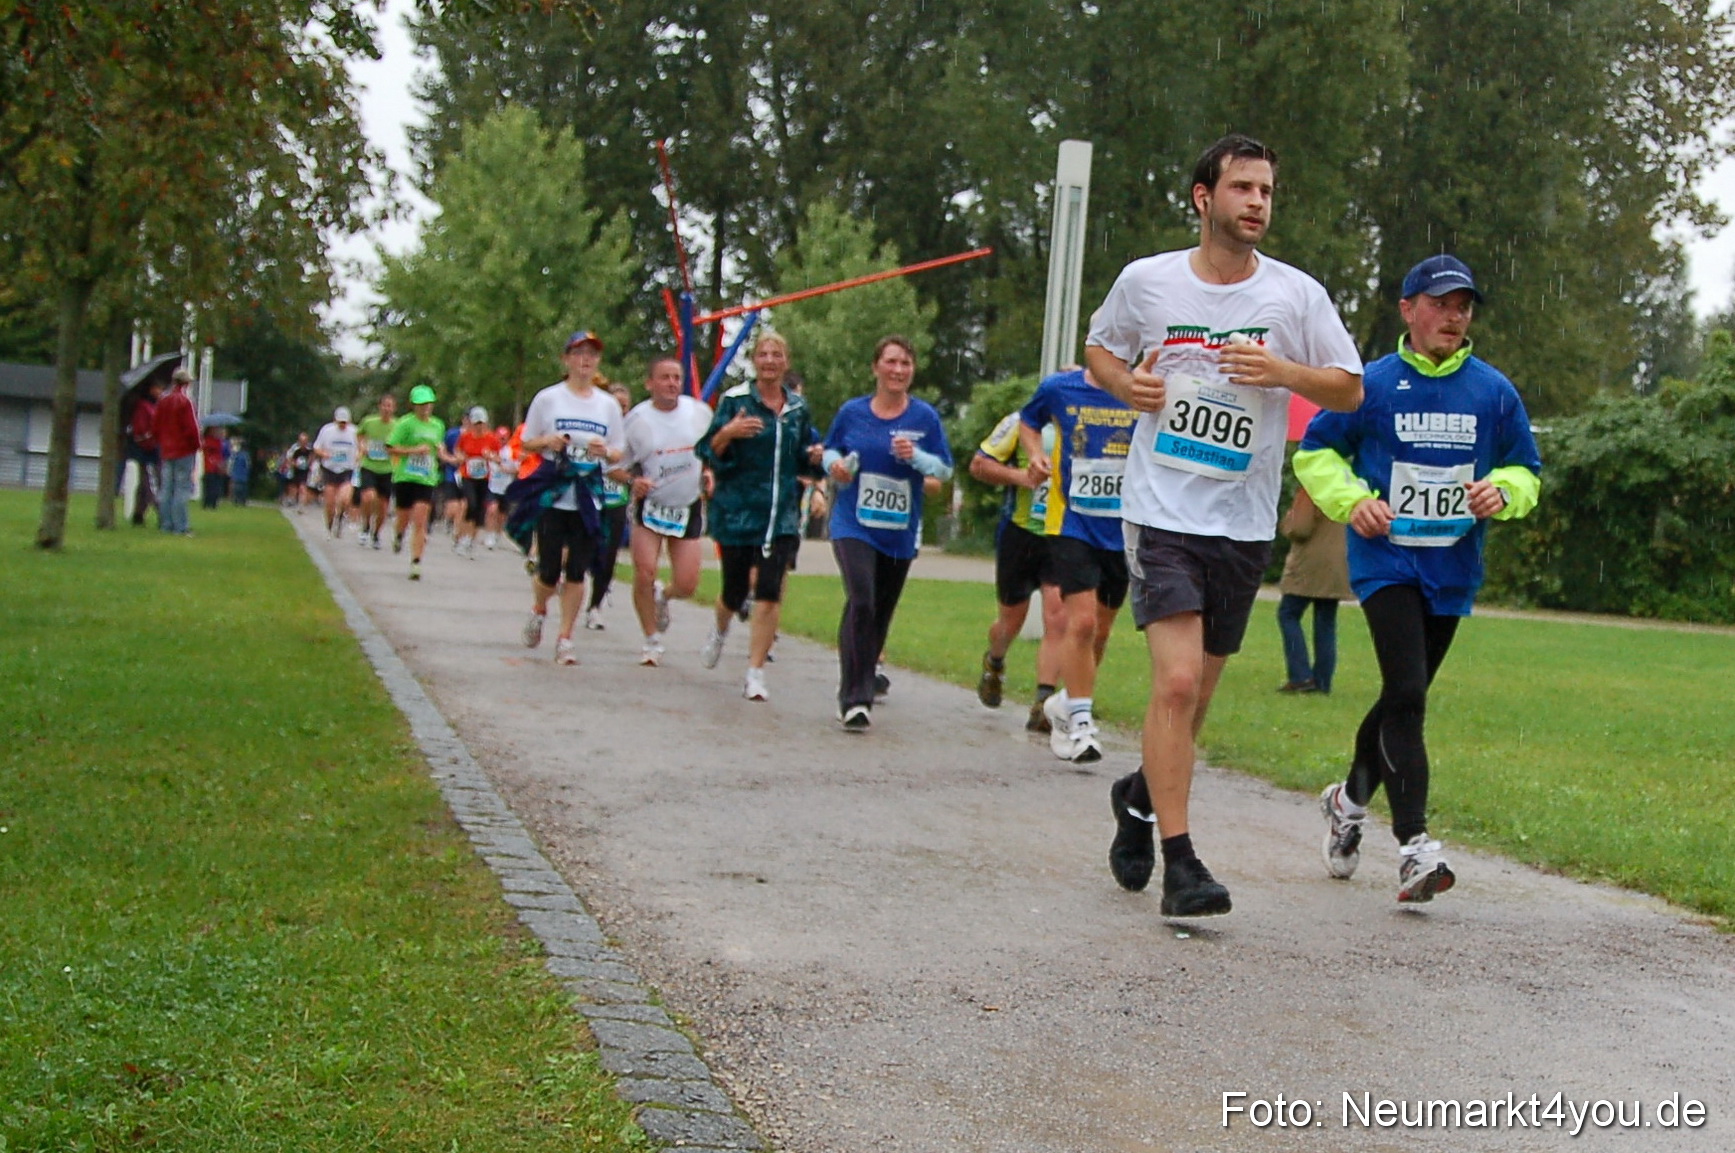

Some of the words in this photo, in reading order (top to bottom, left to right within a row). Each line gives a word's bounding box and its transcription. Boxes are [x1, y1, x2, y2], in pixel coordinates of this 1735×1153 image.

[1169, 400, 1254, 449] 3096
[1394, 412, 1478, 433] HUBER
[1413, 432, 1473, 441] TECHNOLOGY
[1171, 440, 1235, 467] Sebastian
[863, 488, 908, 512] 2903
[1398, 485, 1466, 517] 2162
